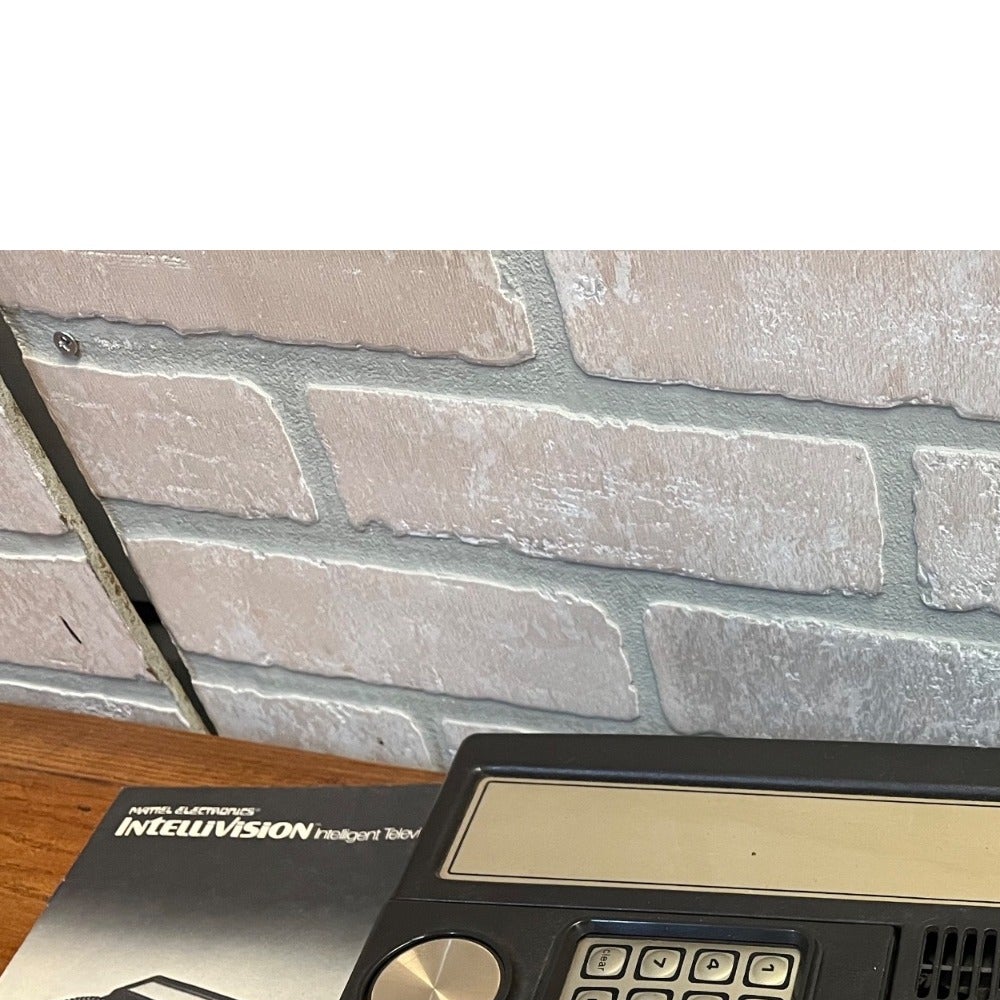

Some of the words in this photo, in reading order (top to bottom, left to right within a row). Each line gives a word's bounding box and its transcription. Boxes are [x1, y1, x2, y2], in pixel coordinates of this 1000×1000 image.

[128, 805, 173, 816] MATTEL
[314, 827, 382, 844] Intelligent
[596, 949, 611, 972] clear
